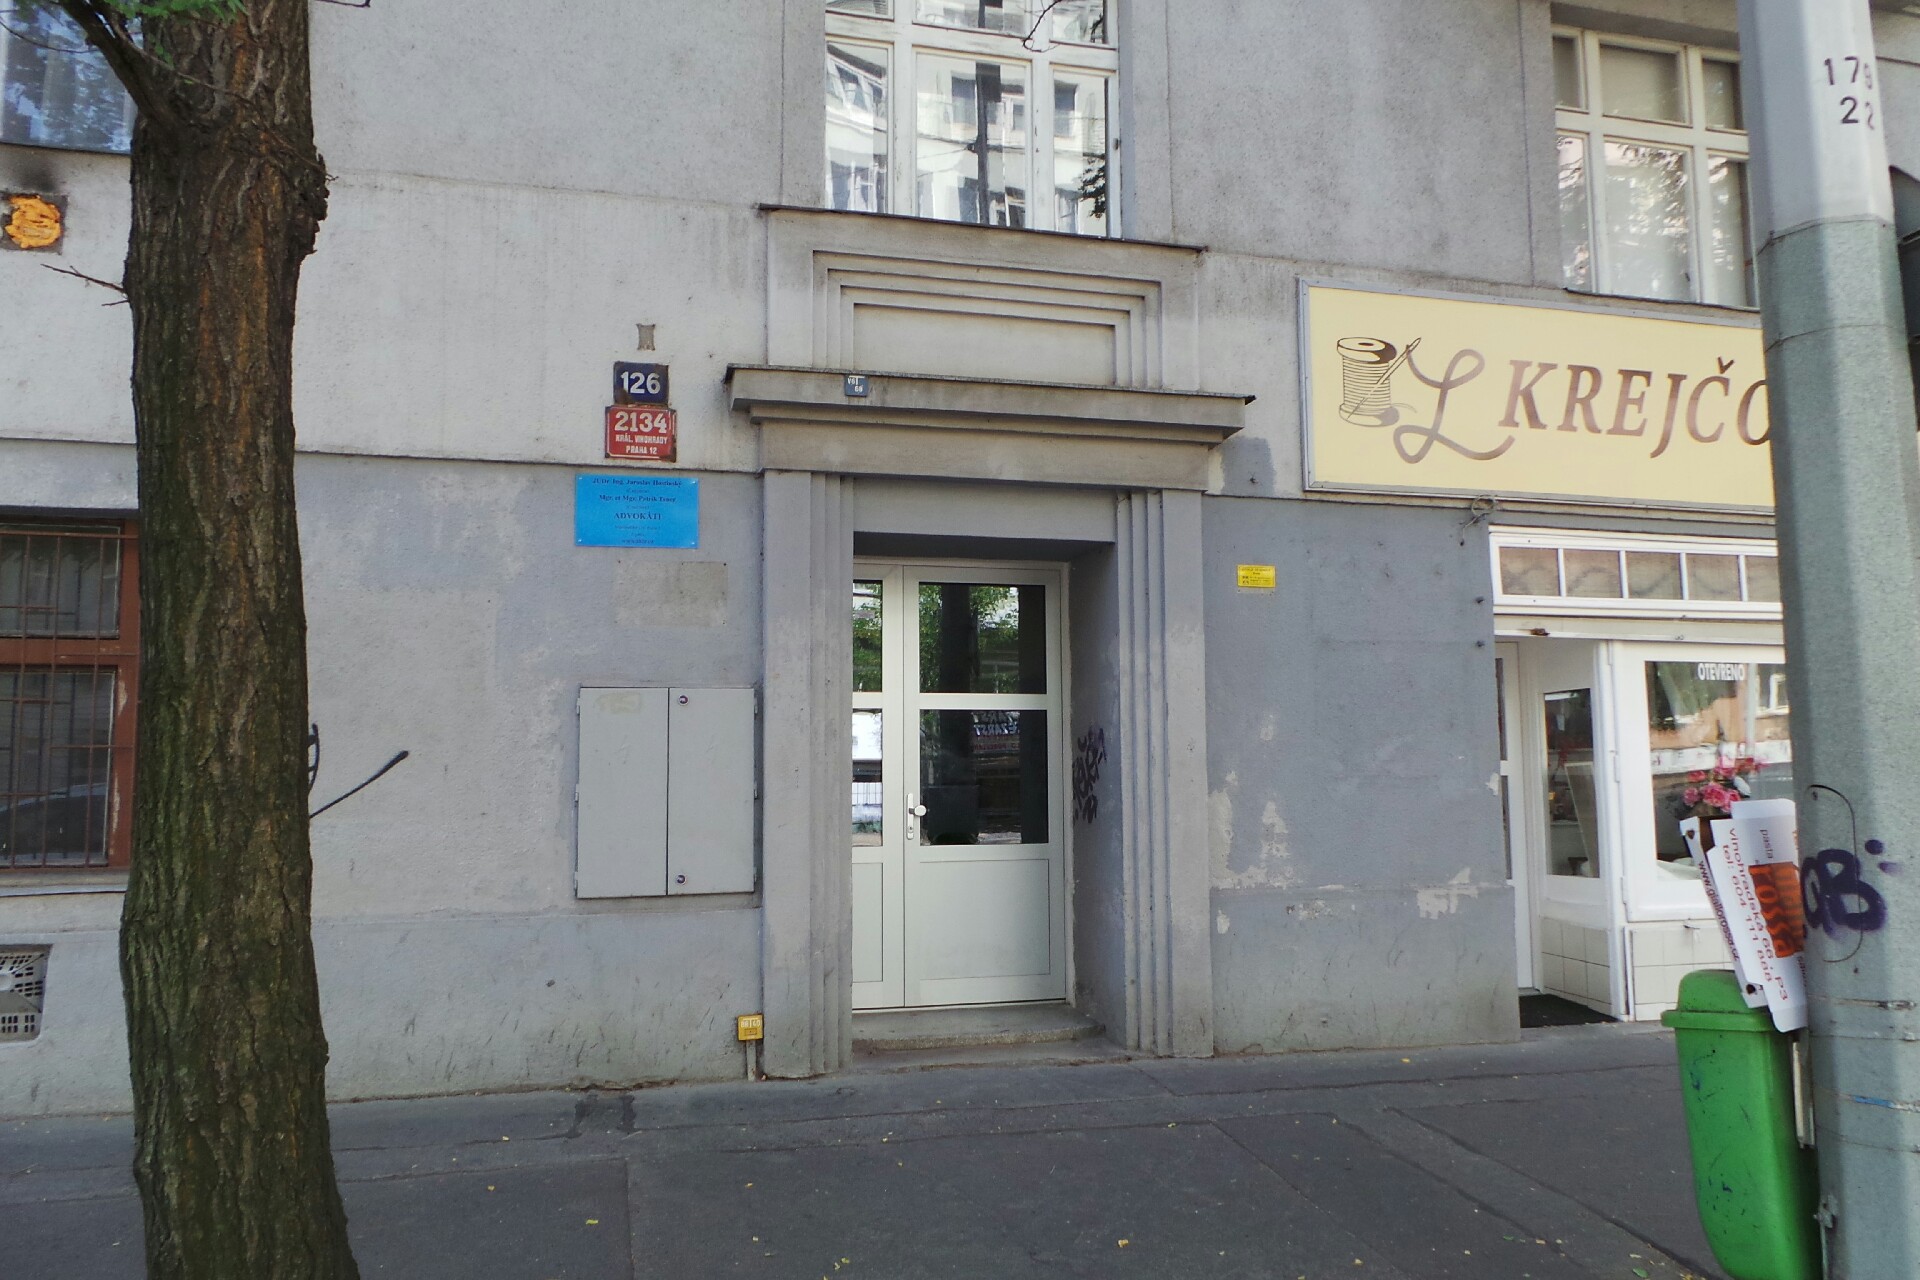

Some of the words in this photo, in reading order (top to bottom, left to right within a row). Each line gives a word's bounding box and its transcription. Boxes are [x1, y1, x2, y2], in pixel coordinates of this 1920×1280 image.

[620, 371, 661, 395] 126
[614, 411, 667, 434] 2134
[625, 445, 647, 454] PRAHA
[649, 446, 658, 455] 12
[1760, 829, 1773, 859] pasta
[1775, 976, 1788, 1001] P3
